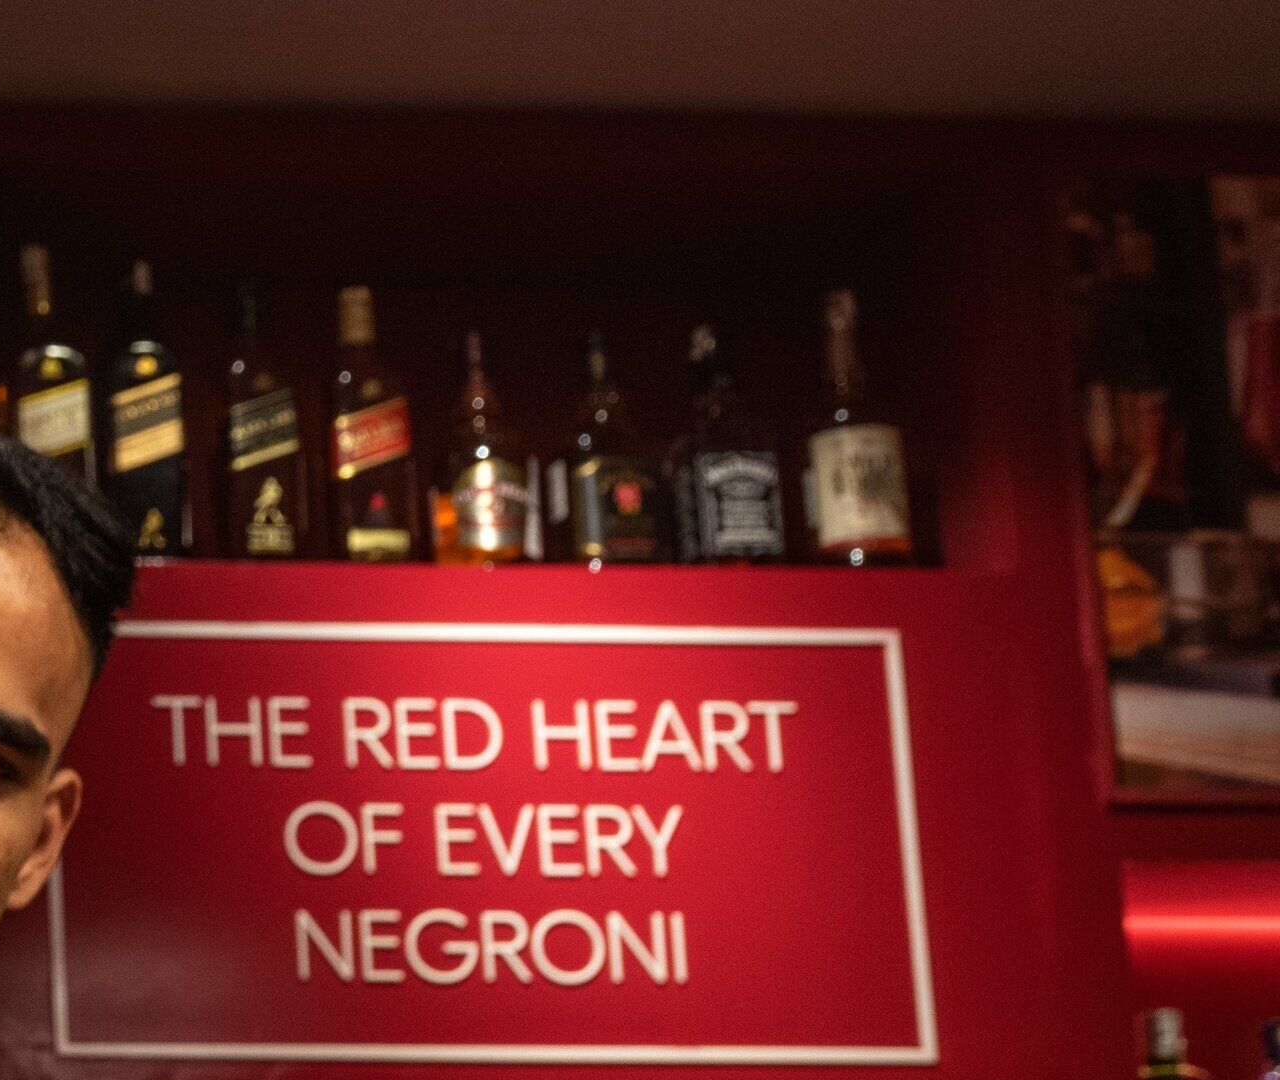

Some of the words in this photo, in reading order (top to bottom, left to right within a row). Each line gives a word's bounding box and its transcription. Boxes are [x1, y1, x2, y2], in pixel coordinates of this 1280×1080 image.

[152, 696, 312, 768] THE
[342, 697, 504, 771] RED
[530, 699, 797, 772] HEART
[283, 801, 404, 876] OF
[434, 803, 683, 877] EVERY
[295, 908, 688, 985] NEGRONI
